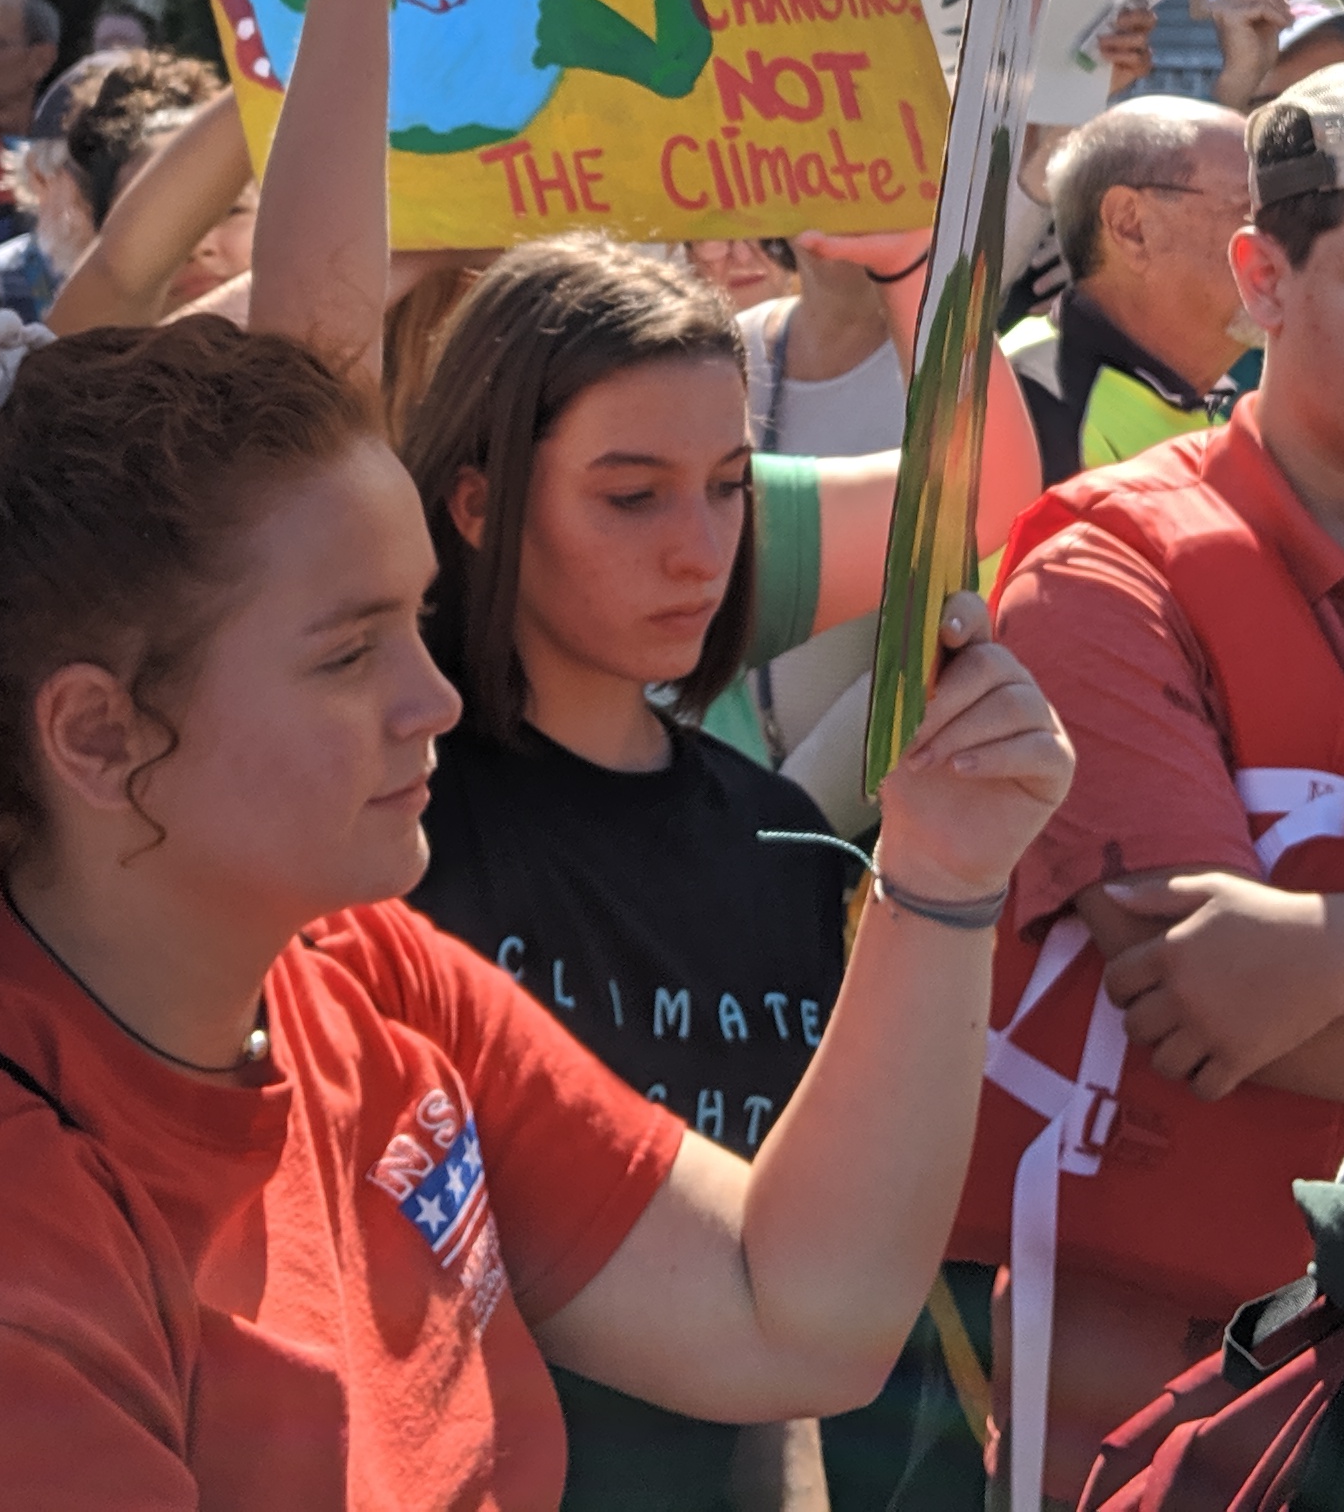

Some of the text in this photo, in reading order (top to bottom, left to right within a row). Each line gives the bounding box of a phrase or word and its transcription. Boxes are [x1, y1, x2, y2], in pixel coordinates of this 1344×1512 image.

[713, 50, 871, 125] NOT
[480, 138, 611, 217] THE
[498, 935, 822, 1046] CLIMATE
